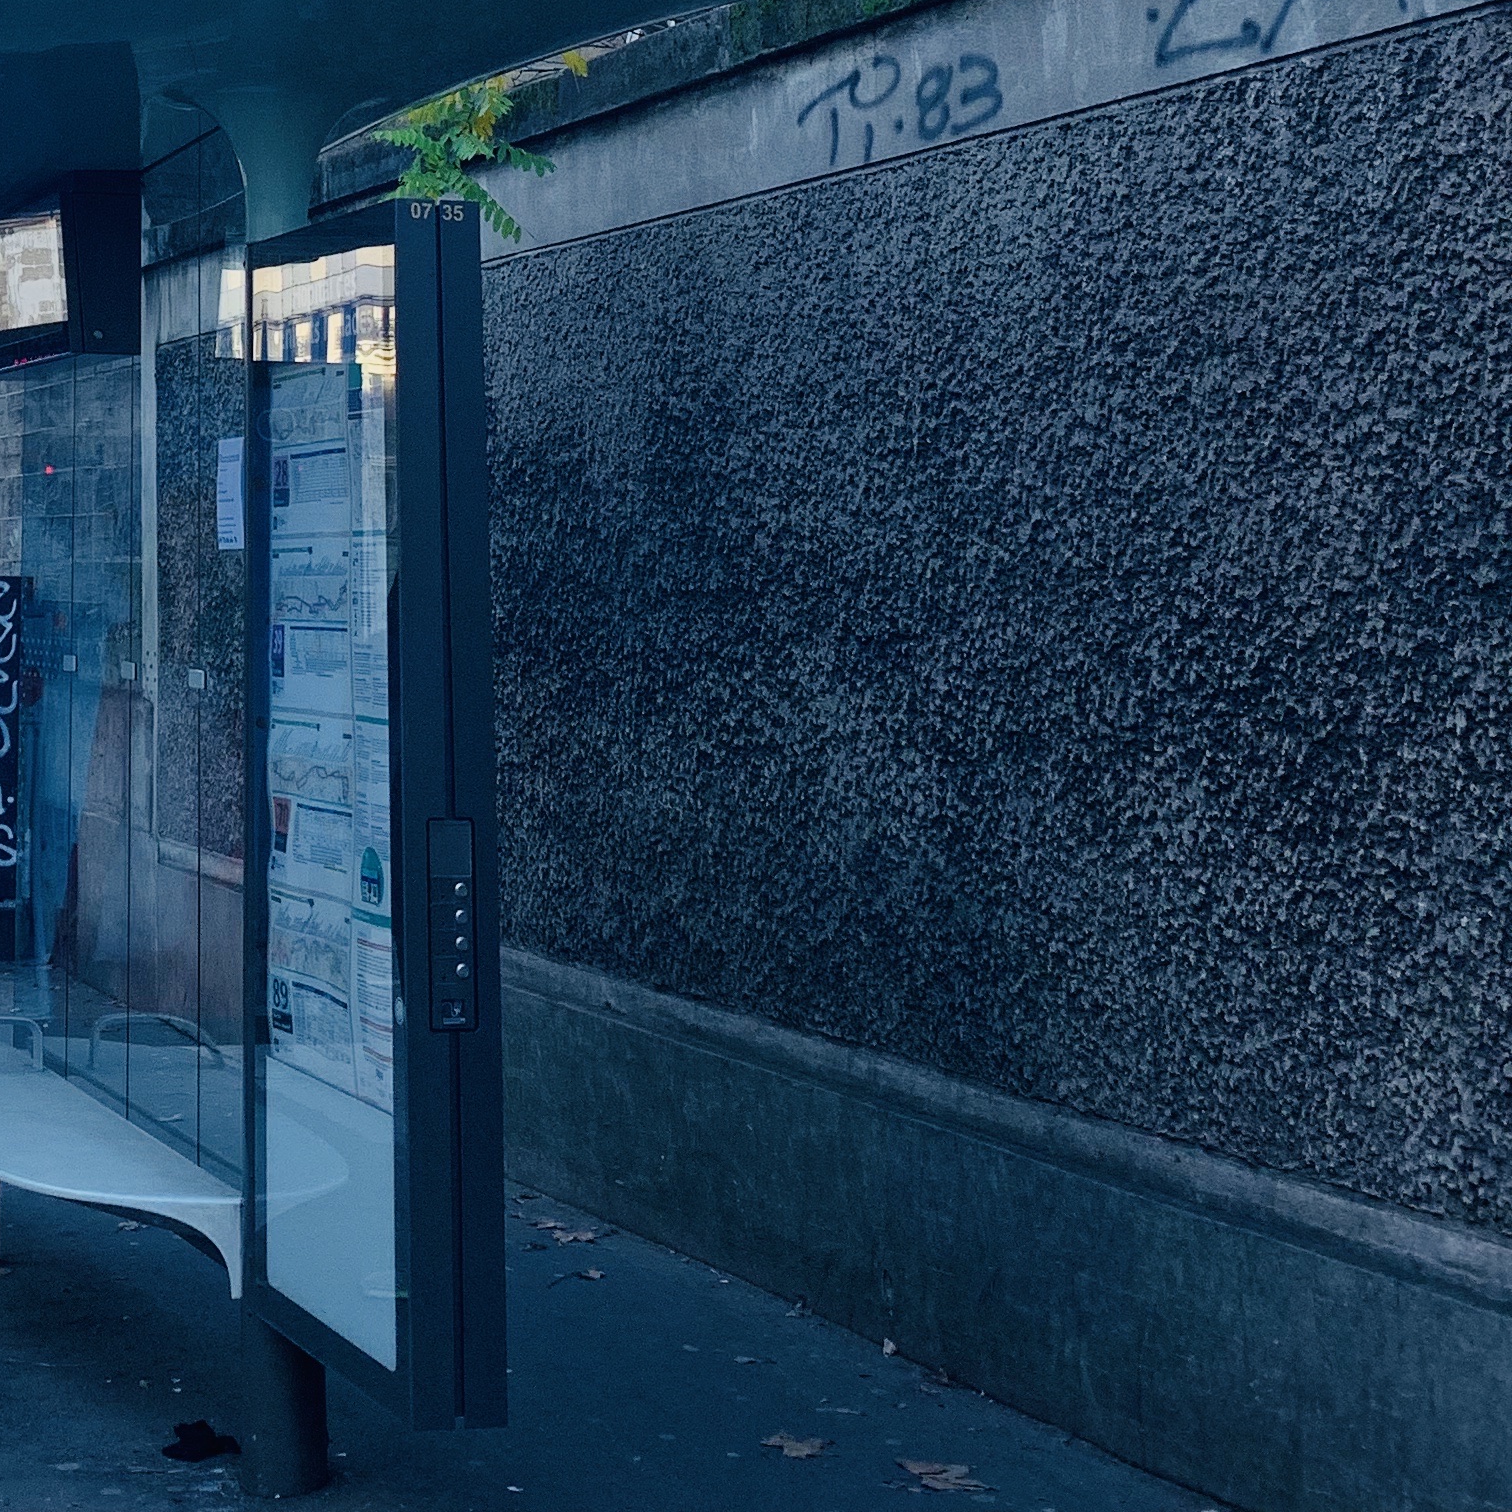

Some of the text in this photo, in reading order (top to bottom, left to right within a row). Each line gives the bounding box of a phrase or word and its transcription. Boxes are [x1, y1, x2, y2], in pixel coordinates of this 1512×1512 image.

[410, 202, 433, 220] 07
[441, 204, 465, 222] 35
[273, 978, 288, 1009] 89
